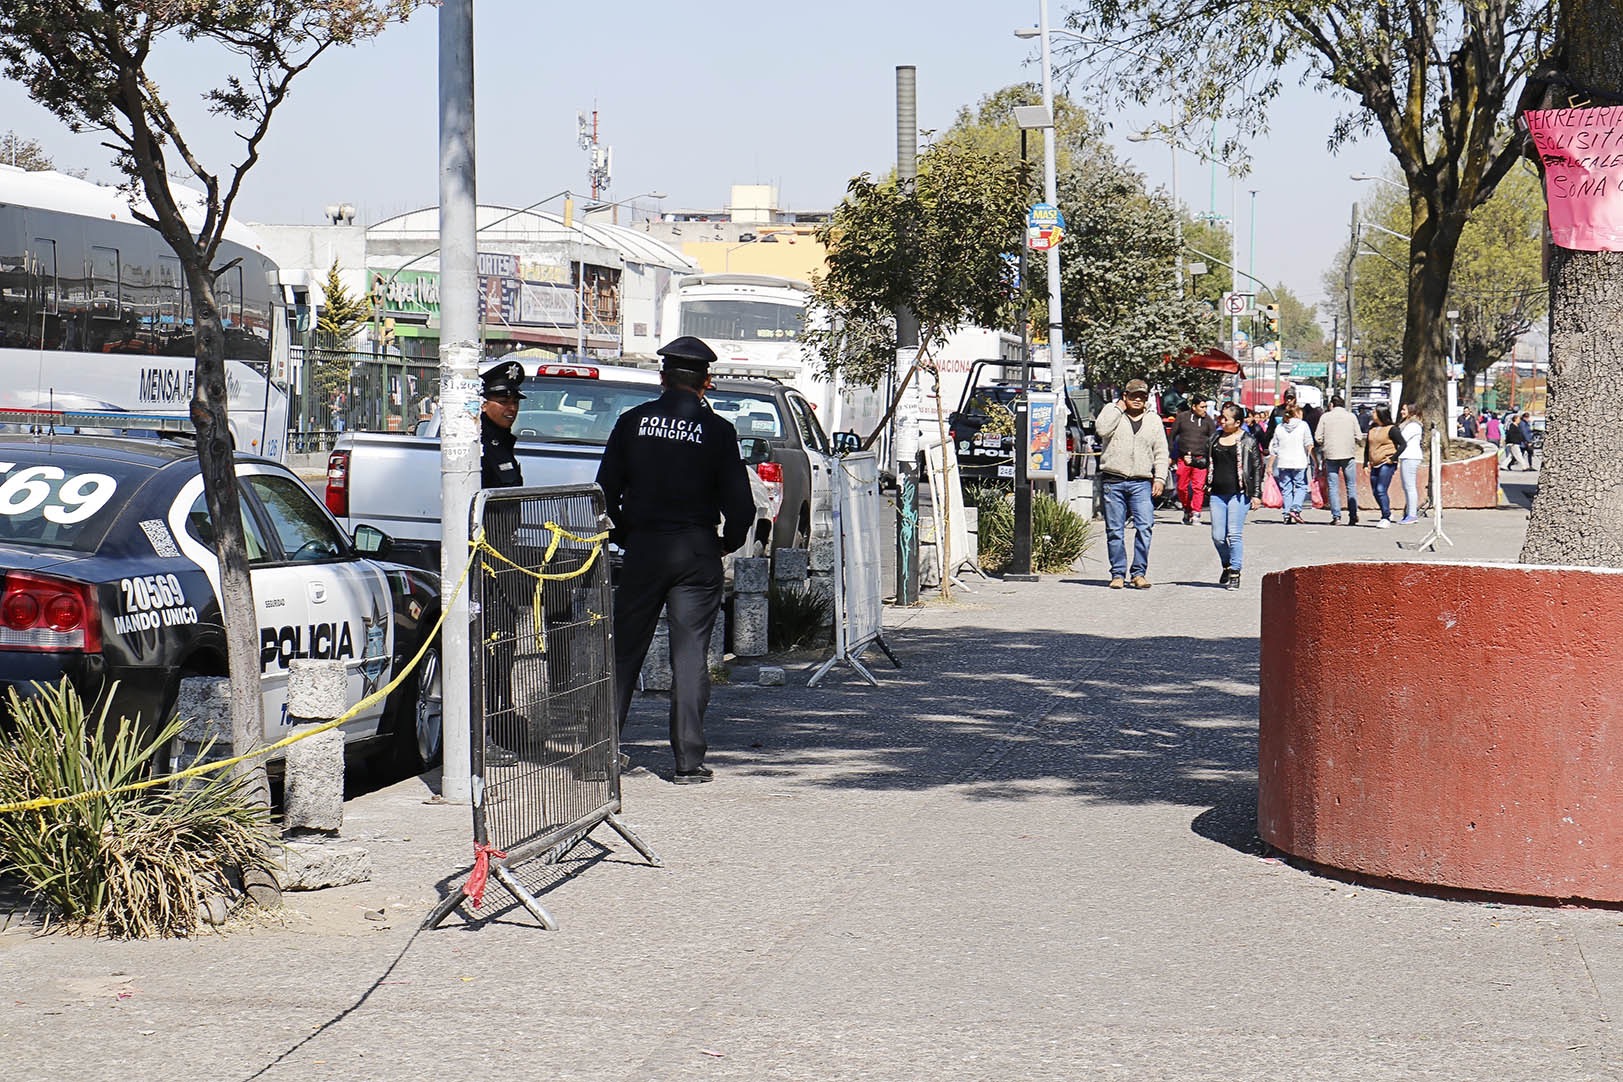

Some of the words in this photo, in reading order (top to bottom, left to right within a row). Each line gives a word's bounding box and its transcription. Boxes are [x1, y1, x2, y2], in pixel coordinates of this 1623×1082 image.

[1567, 154, 1623, 168] LOCALE
[1554, 175, 1607, 198] SONA
[936, 359, 974, 373] NACIONA
[638, 426, 702, 444] MUNICIPAL
[0, 462, 117, 524] 69
[121, 573, 185, 613] 20569
[113, 610, 161, 635] MANDO
[161, 606, 198, 627] UNICO
[260, 621, 354, 674] POLICIA
